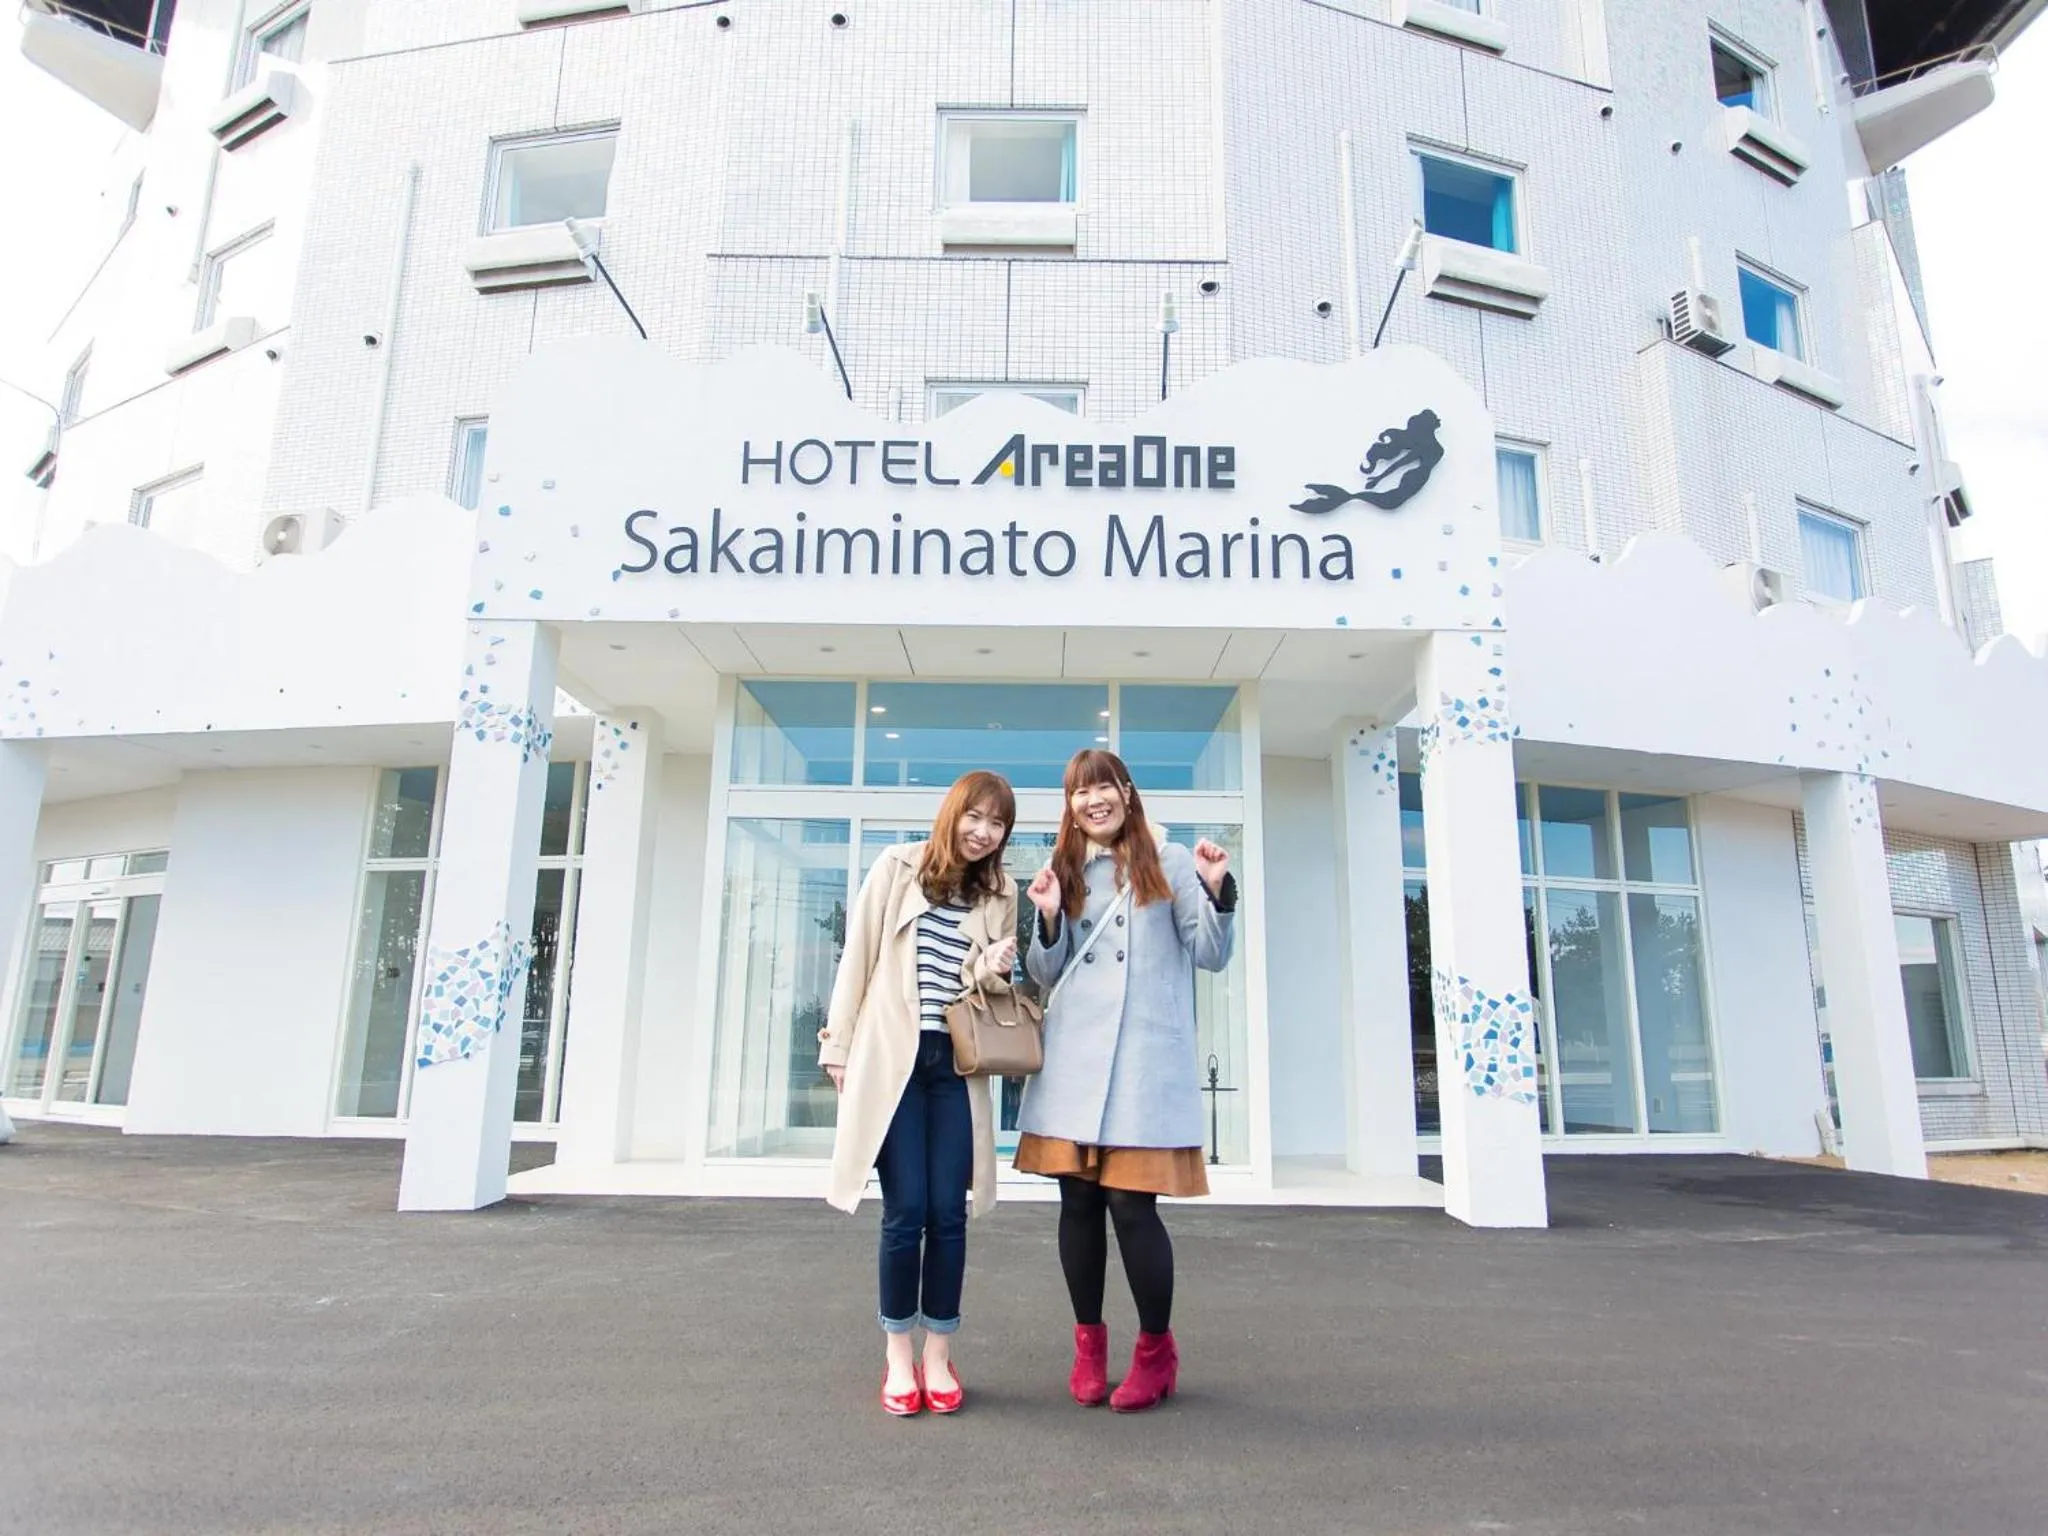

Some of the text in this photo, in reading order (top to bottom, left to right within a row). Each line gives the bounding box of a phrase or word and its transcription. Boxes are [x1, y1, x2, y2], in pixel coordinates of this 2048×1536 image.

[742, 433, 1236, 490] HOTEL AreaOne
[620, 507, 1356, 581] Sakaiminato Marina
